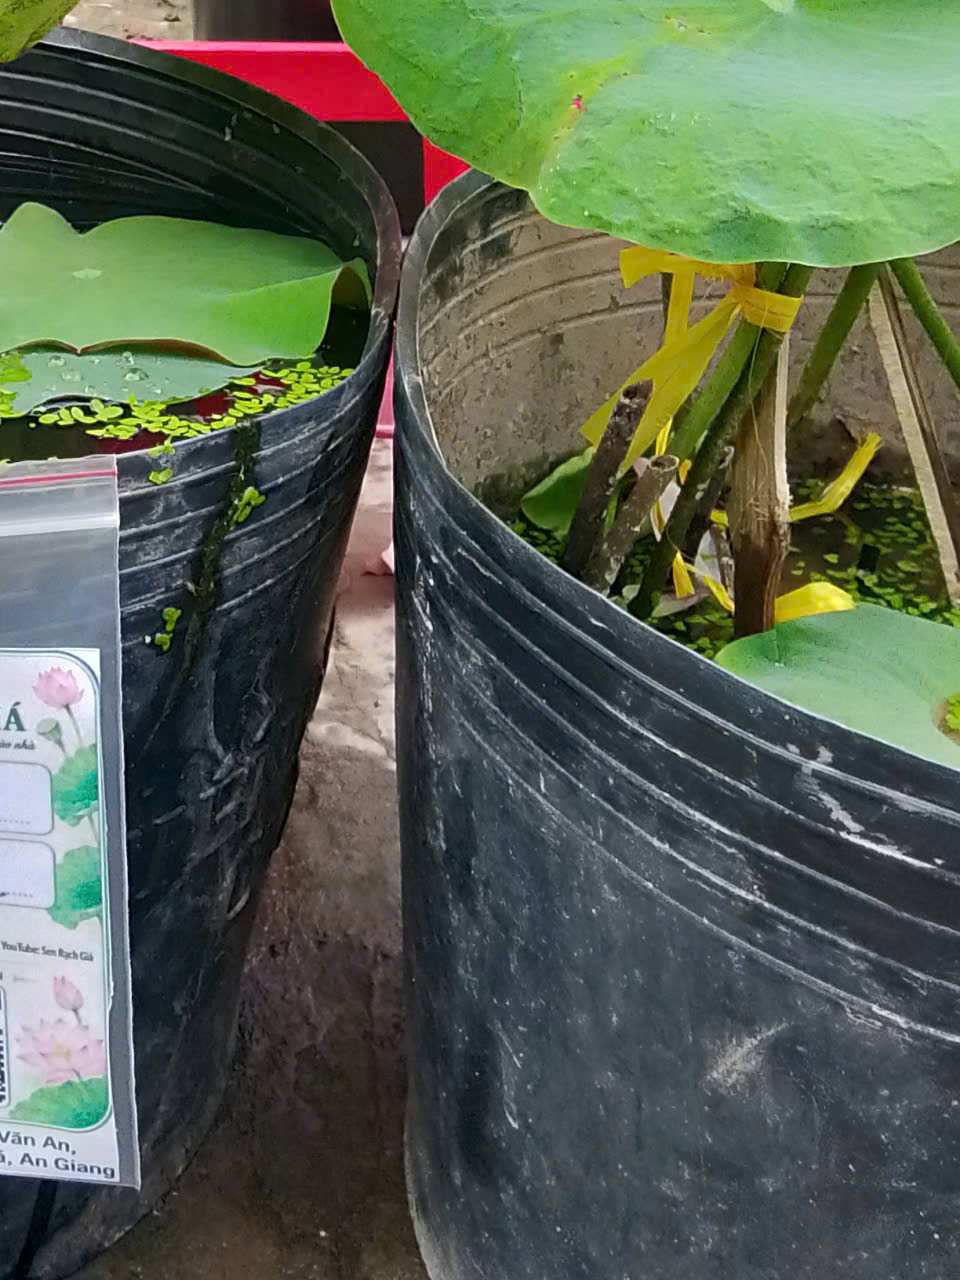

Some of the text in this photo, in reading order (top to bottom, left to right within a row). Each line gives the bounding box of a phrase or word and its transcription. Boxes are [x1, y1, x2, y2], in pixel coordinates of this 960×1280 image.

[13, 738, 36, 751] nhà
[41, 946, 57, 956] Sen
[42, 1135, 77, 1155] An,
[19, 1151, 48, 1168] An
[54, 1157, 116, 1180] Giang
